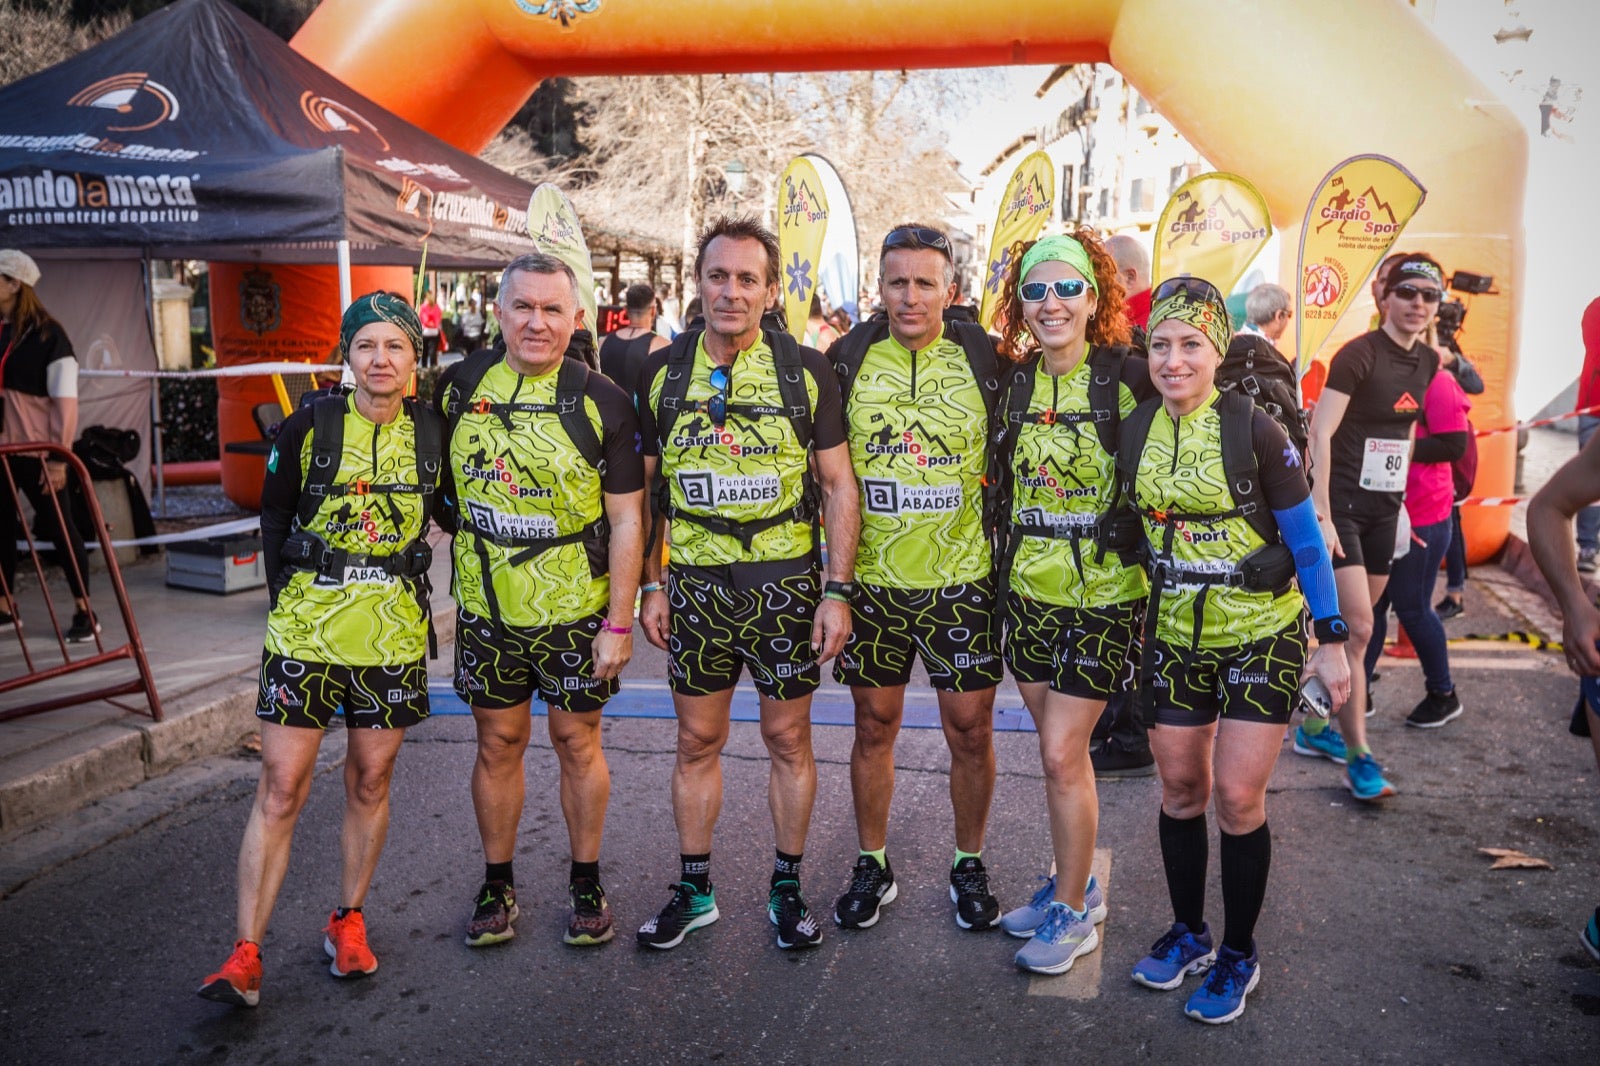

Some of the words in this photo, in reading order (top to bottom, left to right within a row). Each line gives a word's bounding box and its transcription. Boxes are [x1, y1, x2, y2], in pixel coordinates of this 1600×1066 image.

[8, 211, 116, 225] cronometraje
[119, 209, 199, 224] deportivo
[1221, 227, 1265, 243] Sport
[1364, 221, 1401, 236] Spor
[673, 433, 734, 448] CardiO
[730, 444, 779, 457] Sport
[865, 442, 922, 455] CardiO
[916, 454, 962, 468] Sport
[1385, 455, 1402, 471] 80
[462, 463, 512, 483] CardiO
[719, 477, 778, 488] Fundación
[509, 484, 552, 499] Sport
[717, 486, 778, 502] ABADES
[903, 486, 960, 496] Fundación
[1055, 485, 1097, 500] Sport
[901, 495, 960, 510] ABADES
[325, 519, 376, 533] CardiO
[501, 526, 555, 538] ABADES
[1182, 529, 1229, 543] Sport
[1240, 676, 1268, 684] ABADES
